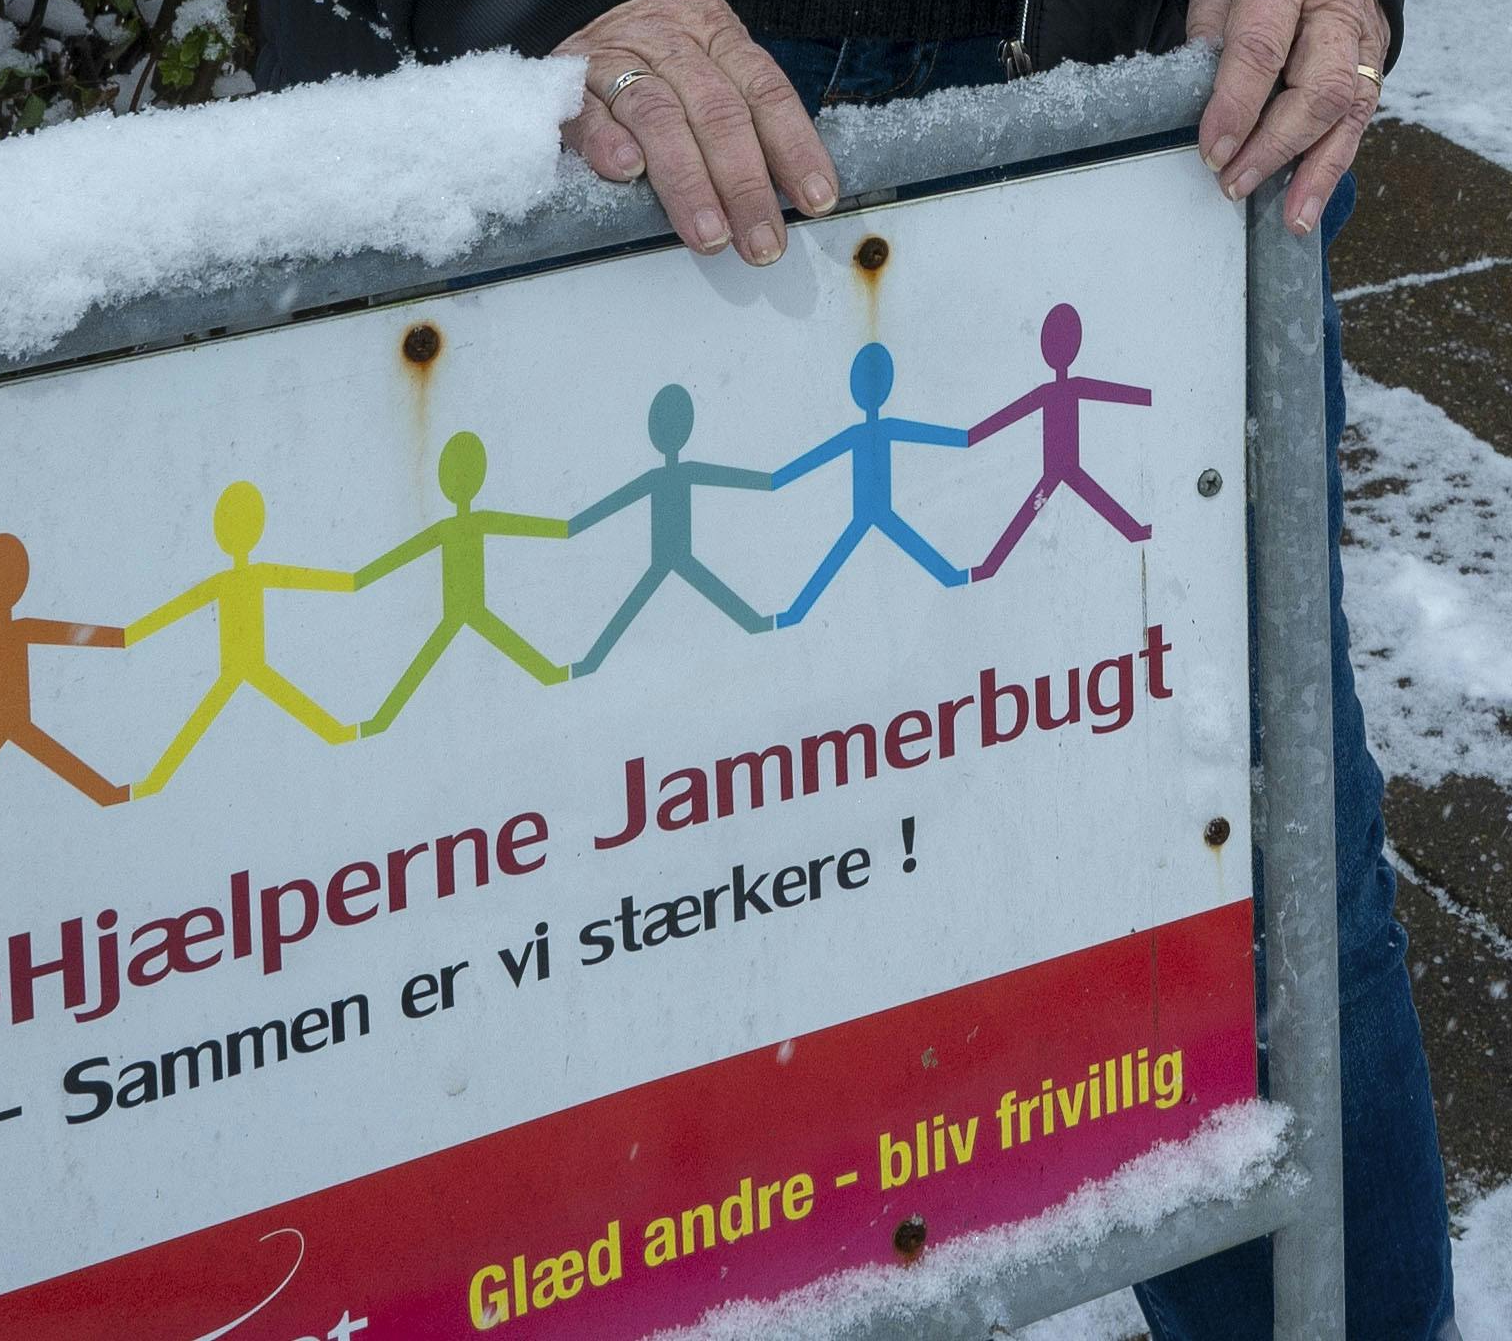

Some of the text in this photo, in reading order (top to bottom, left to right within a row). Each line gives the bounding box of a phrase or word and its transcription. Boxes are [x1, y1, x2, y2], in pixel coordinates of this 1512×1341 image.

[594, 623, 1173, 850] Jammerbugt
[62, 993, 371, 1125] Sammen
[401, 960, 469, 1019] er
[498, 922, 550, 989] vi
[578, 847, 871, 966] stærkere
[467, 1220, 623, 1330] Glæd
[643, 1176, 815, 1268] andre
[879, 1115, 979, 1190] bliv
[995, 1047, 1185, 1149] frivillig
